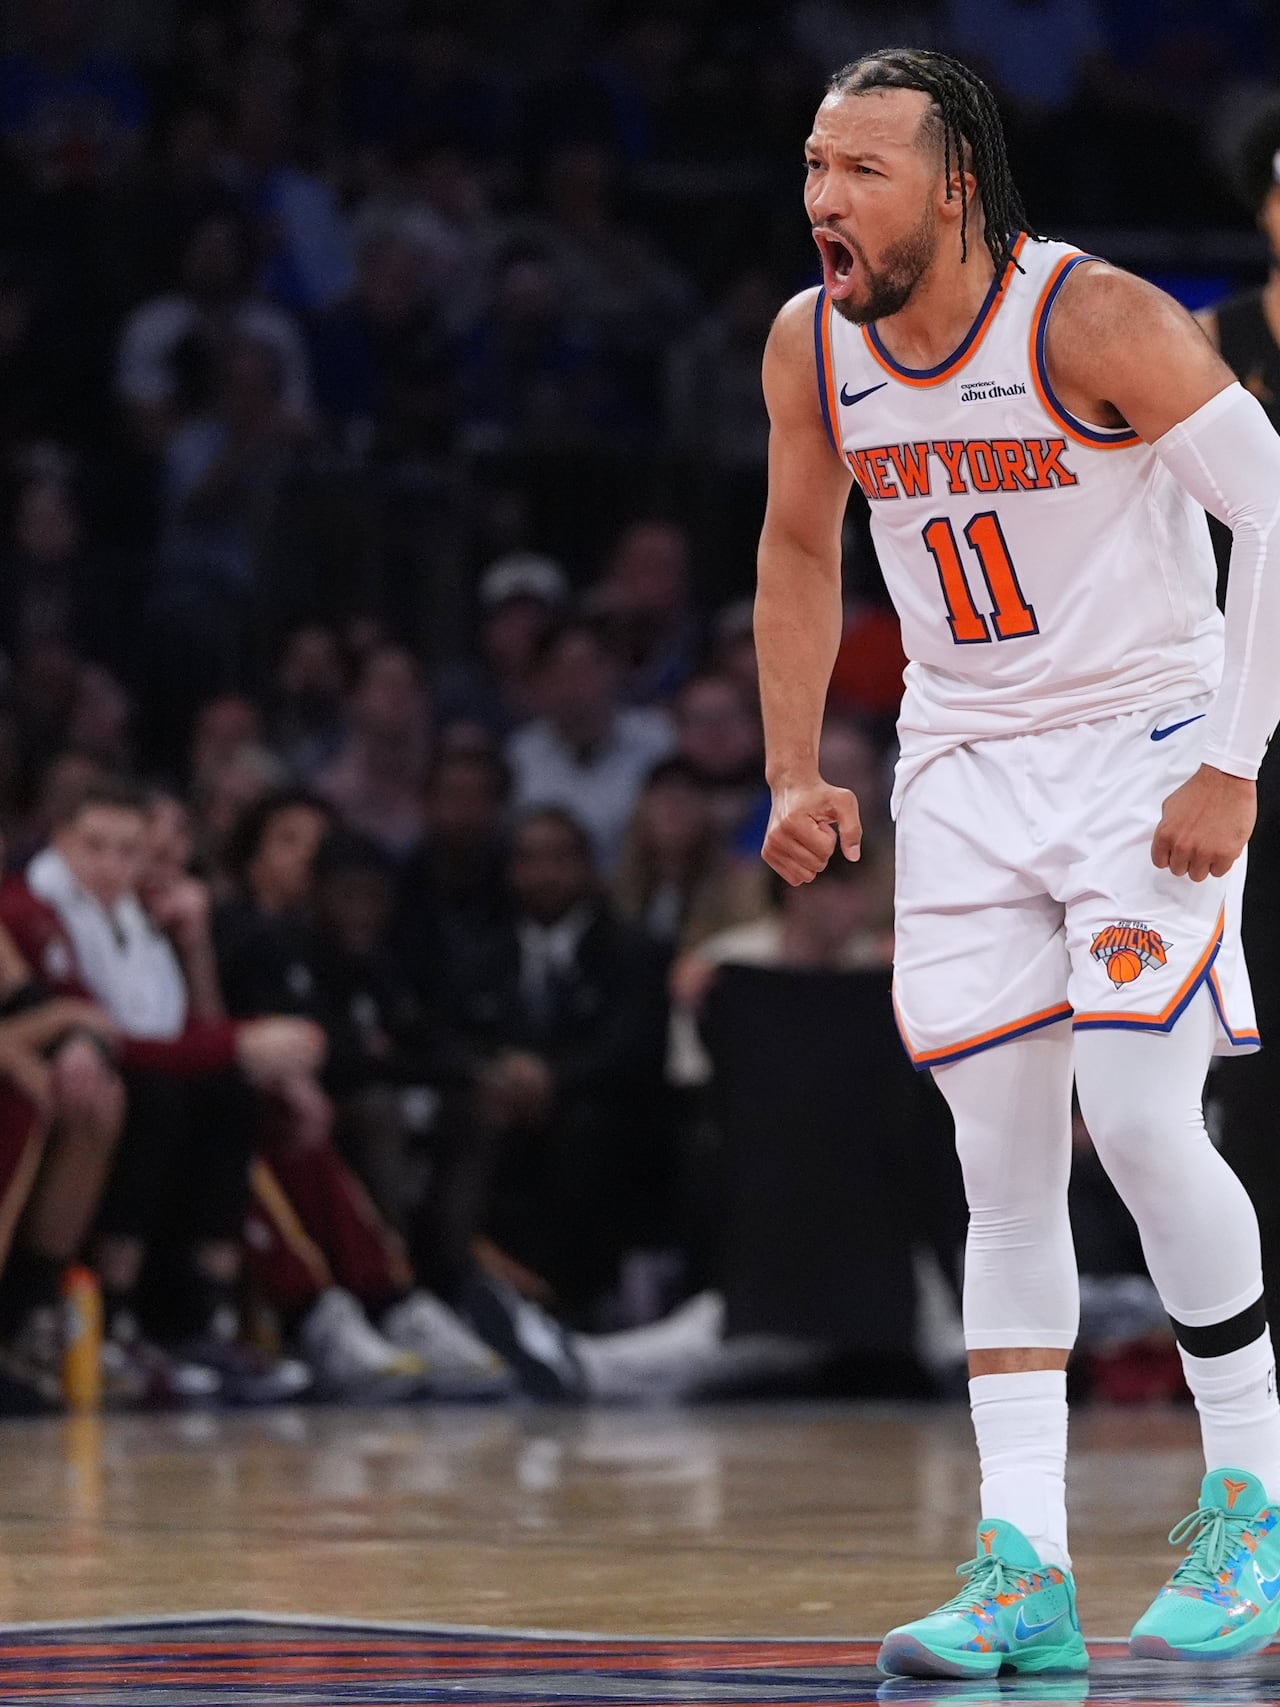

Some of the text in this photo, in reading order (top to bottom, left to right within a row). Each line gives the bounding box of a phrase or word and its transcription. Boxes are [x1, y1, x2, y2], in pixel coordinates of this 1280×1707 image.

[960, 380, 995, 390] experience
[961, 382, 1027, 402] abu dhabi
[844, 438, 1080, 500] NEW YORK
[921, 510, 1040, 645] 11
[1089, 924, 1168, 966] KNICKS
